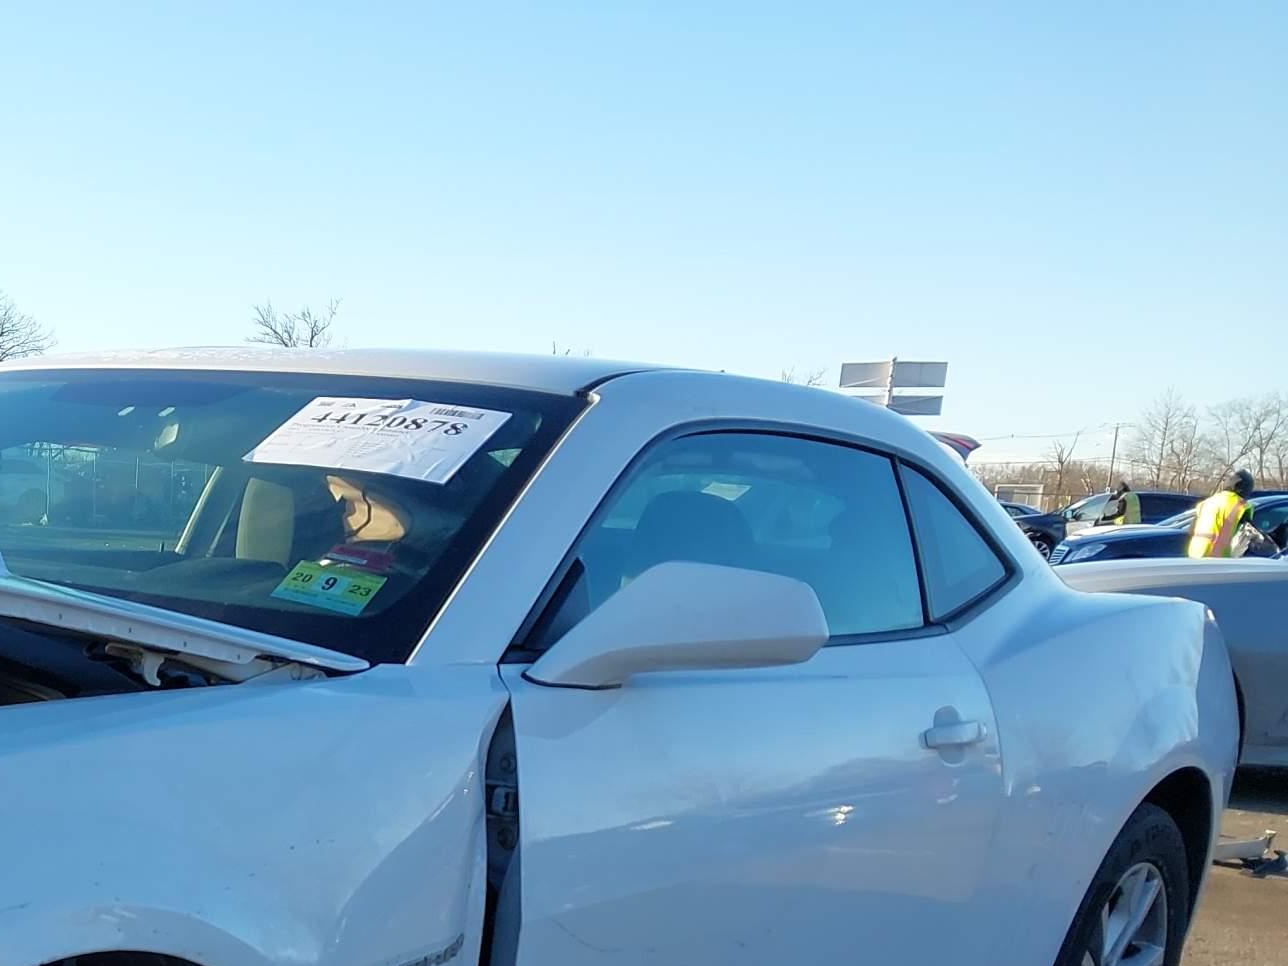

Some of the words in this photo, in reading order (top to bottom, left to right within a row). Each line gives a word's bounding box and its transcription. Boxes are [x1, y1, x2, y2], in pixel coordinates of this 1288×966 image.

[311, 410, 470, 437] 44120878
[292, 571, 313, 584] 20
[320, 576, 339, 591] 9
[347, 584, 372, 597] 23
